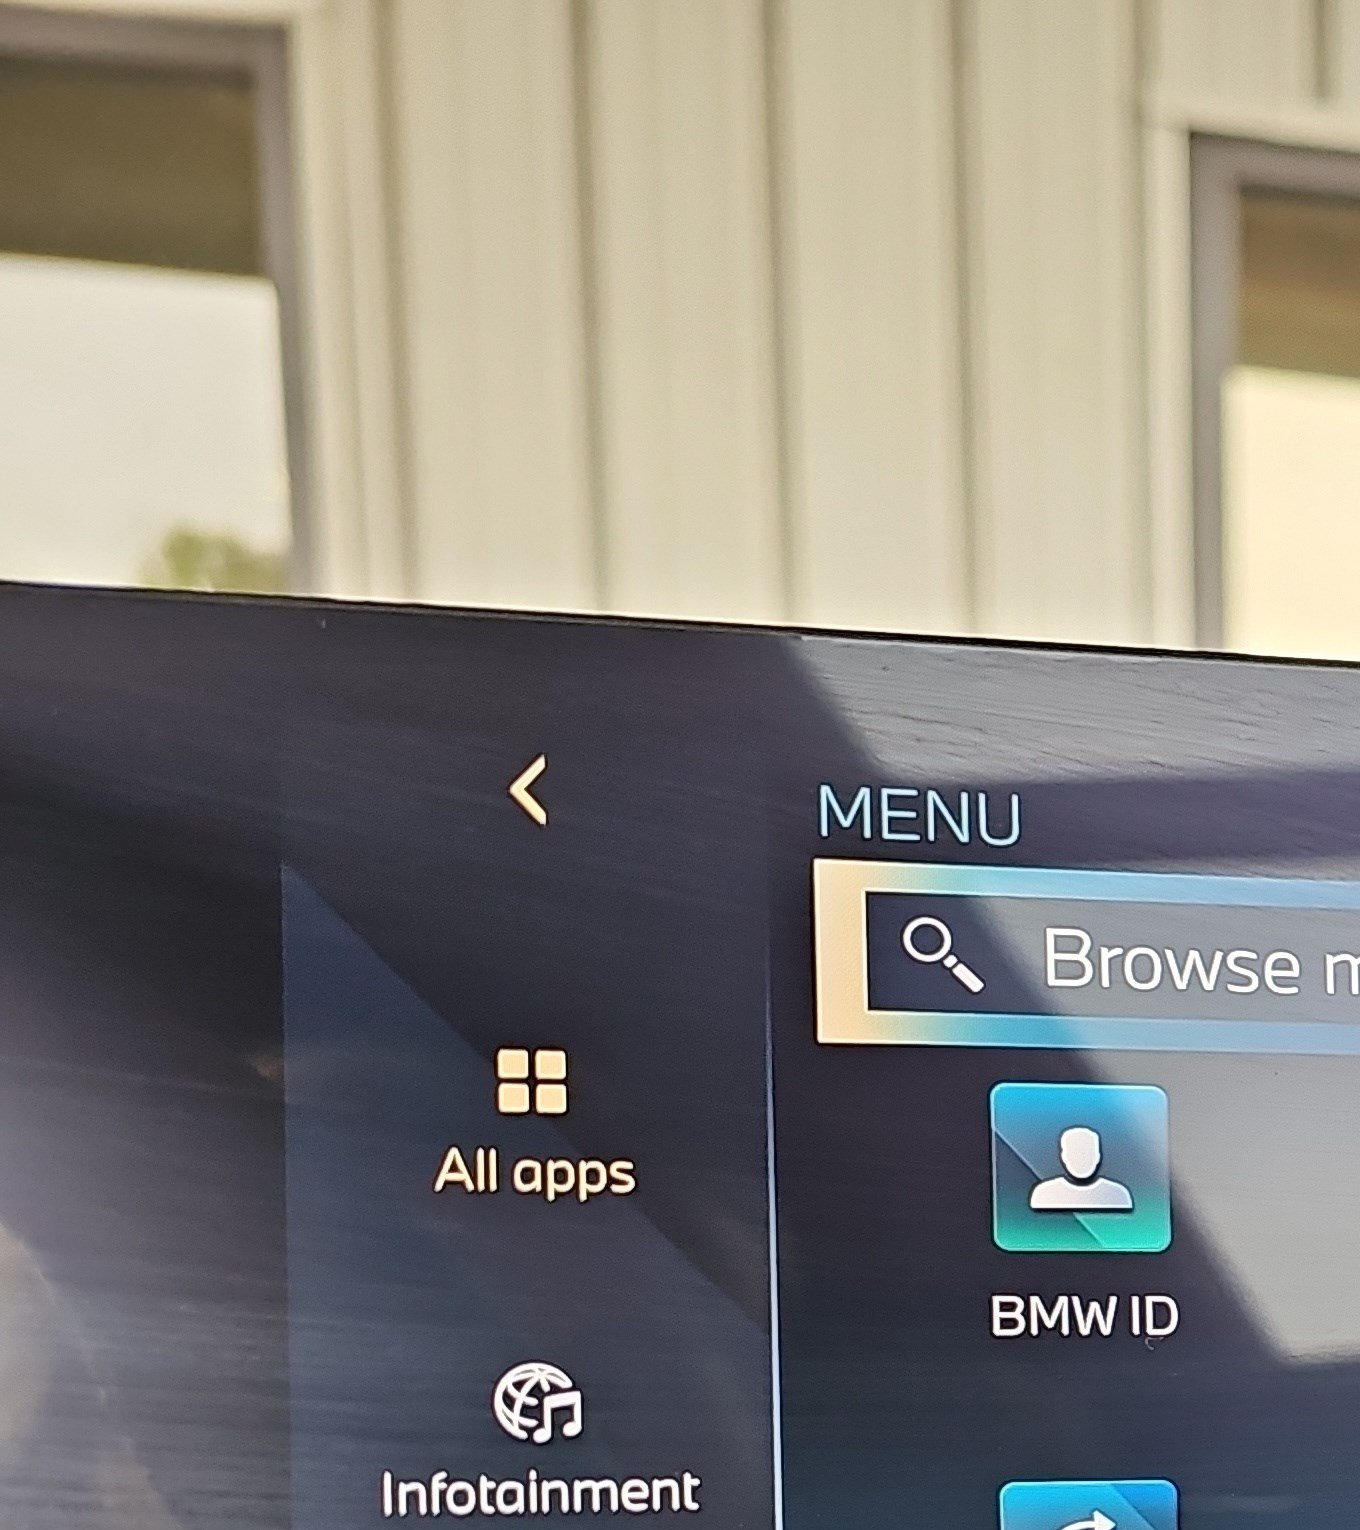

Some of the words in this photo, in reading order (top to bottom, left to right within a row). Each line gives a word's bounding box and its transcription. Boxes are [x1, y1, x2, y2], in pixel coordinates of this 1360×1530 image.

[818, 784, 1022, 846] MENU
[1045, 927, 1300, 996] Browse
[434, 1146, 499, 1193] All
[512, 1157, 637, 1202] apps
[990, 1295, 1117, 1337] BMW
[1130, 1296, 1179, 1338] ID
[381, 1470, 701, 1517] Infotainment
